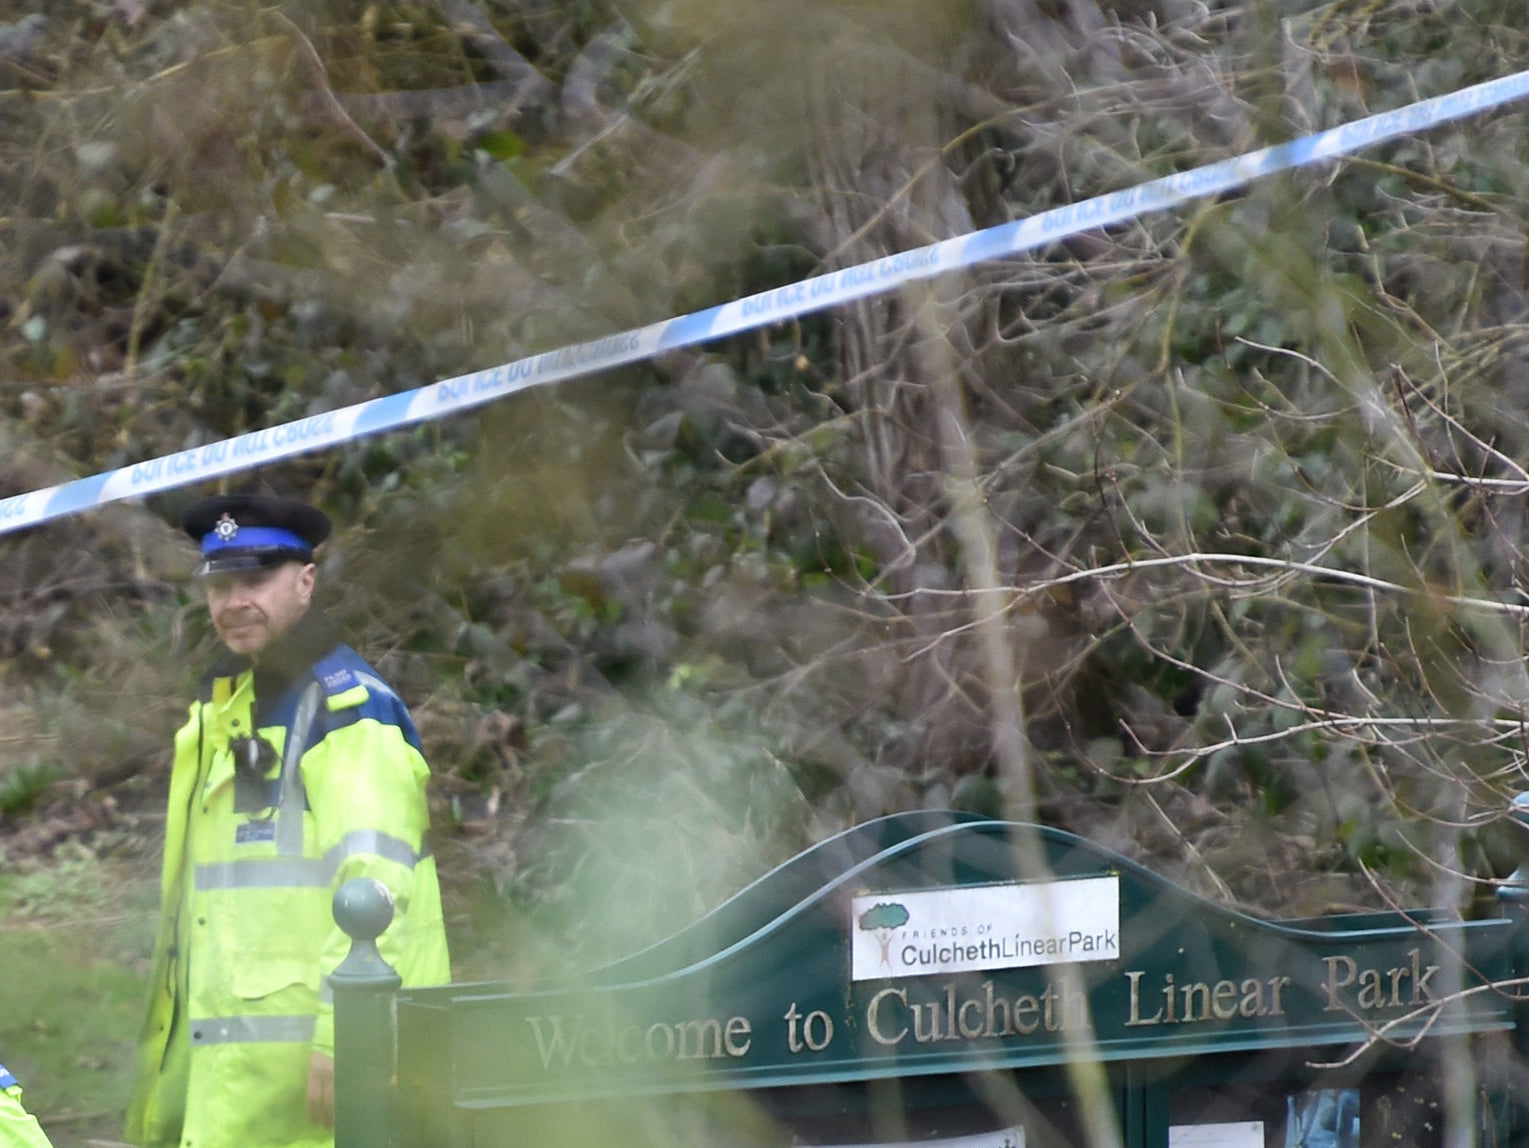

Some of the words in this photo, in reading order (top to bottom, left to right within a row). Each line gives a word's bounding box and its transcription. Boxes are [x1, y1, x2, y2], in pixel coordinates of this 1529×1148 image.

[900, 929, 1117, 966] CulchethLinearPark
[902, 926, 968, 940] FRIENDS
[977, 924, 992, 935] OF
[525, 1008, 753, 1071] Welcome
[784, 1002, 835, 1054] to
[867, 977, 1091, 1045] Culcheth
[1124, 971, 1292, 1028] Linear
[1322, 949, 1440, 1013] Park
